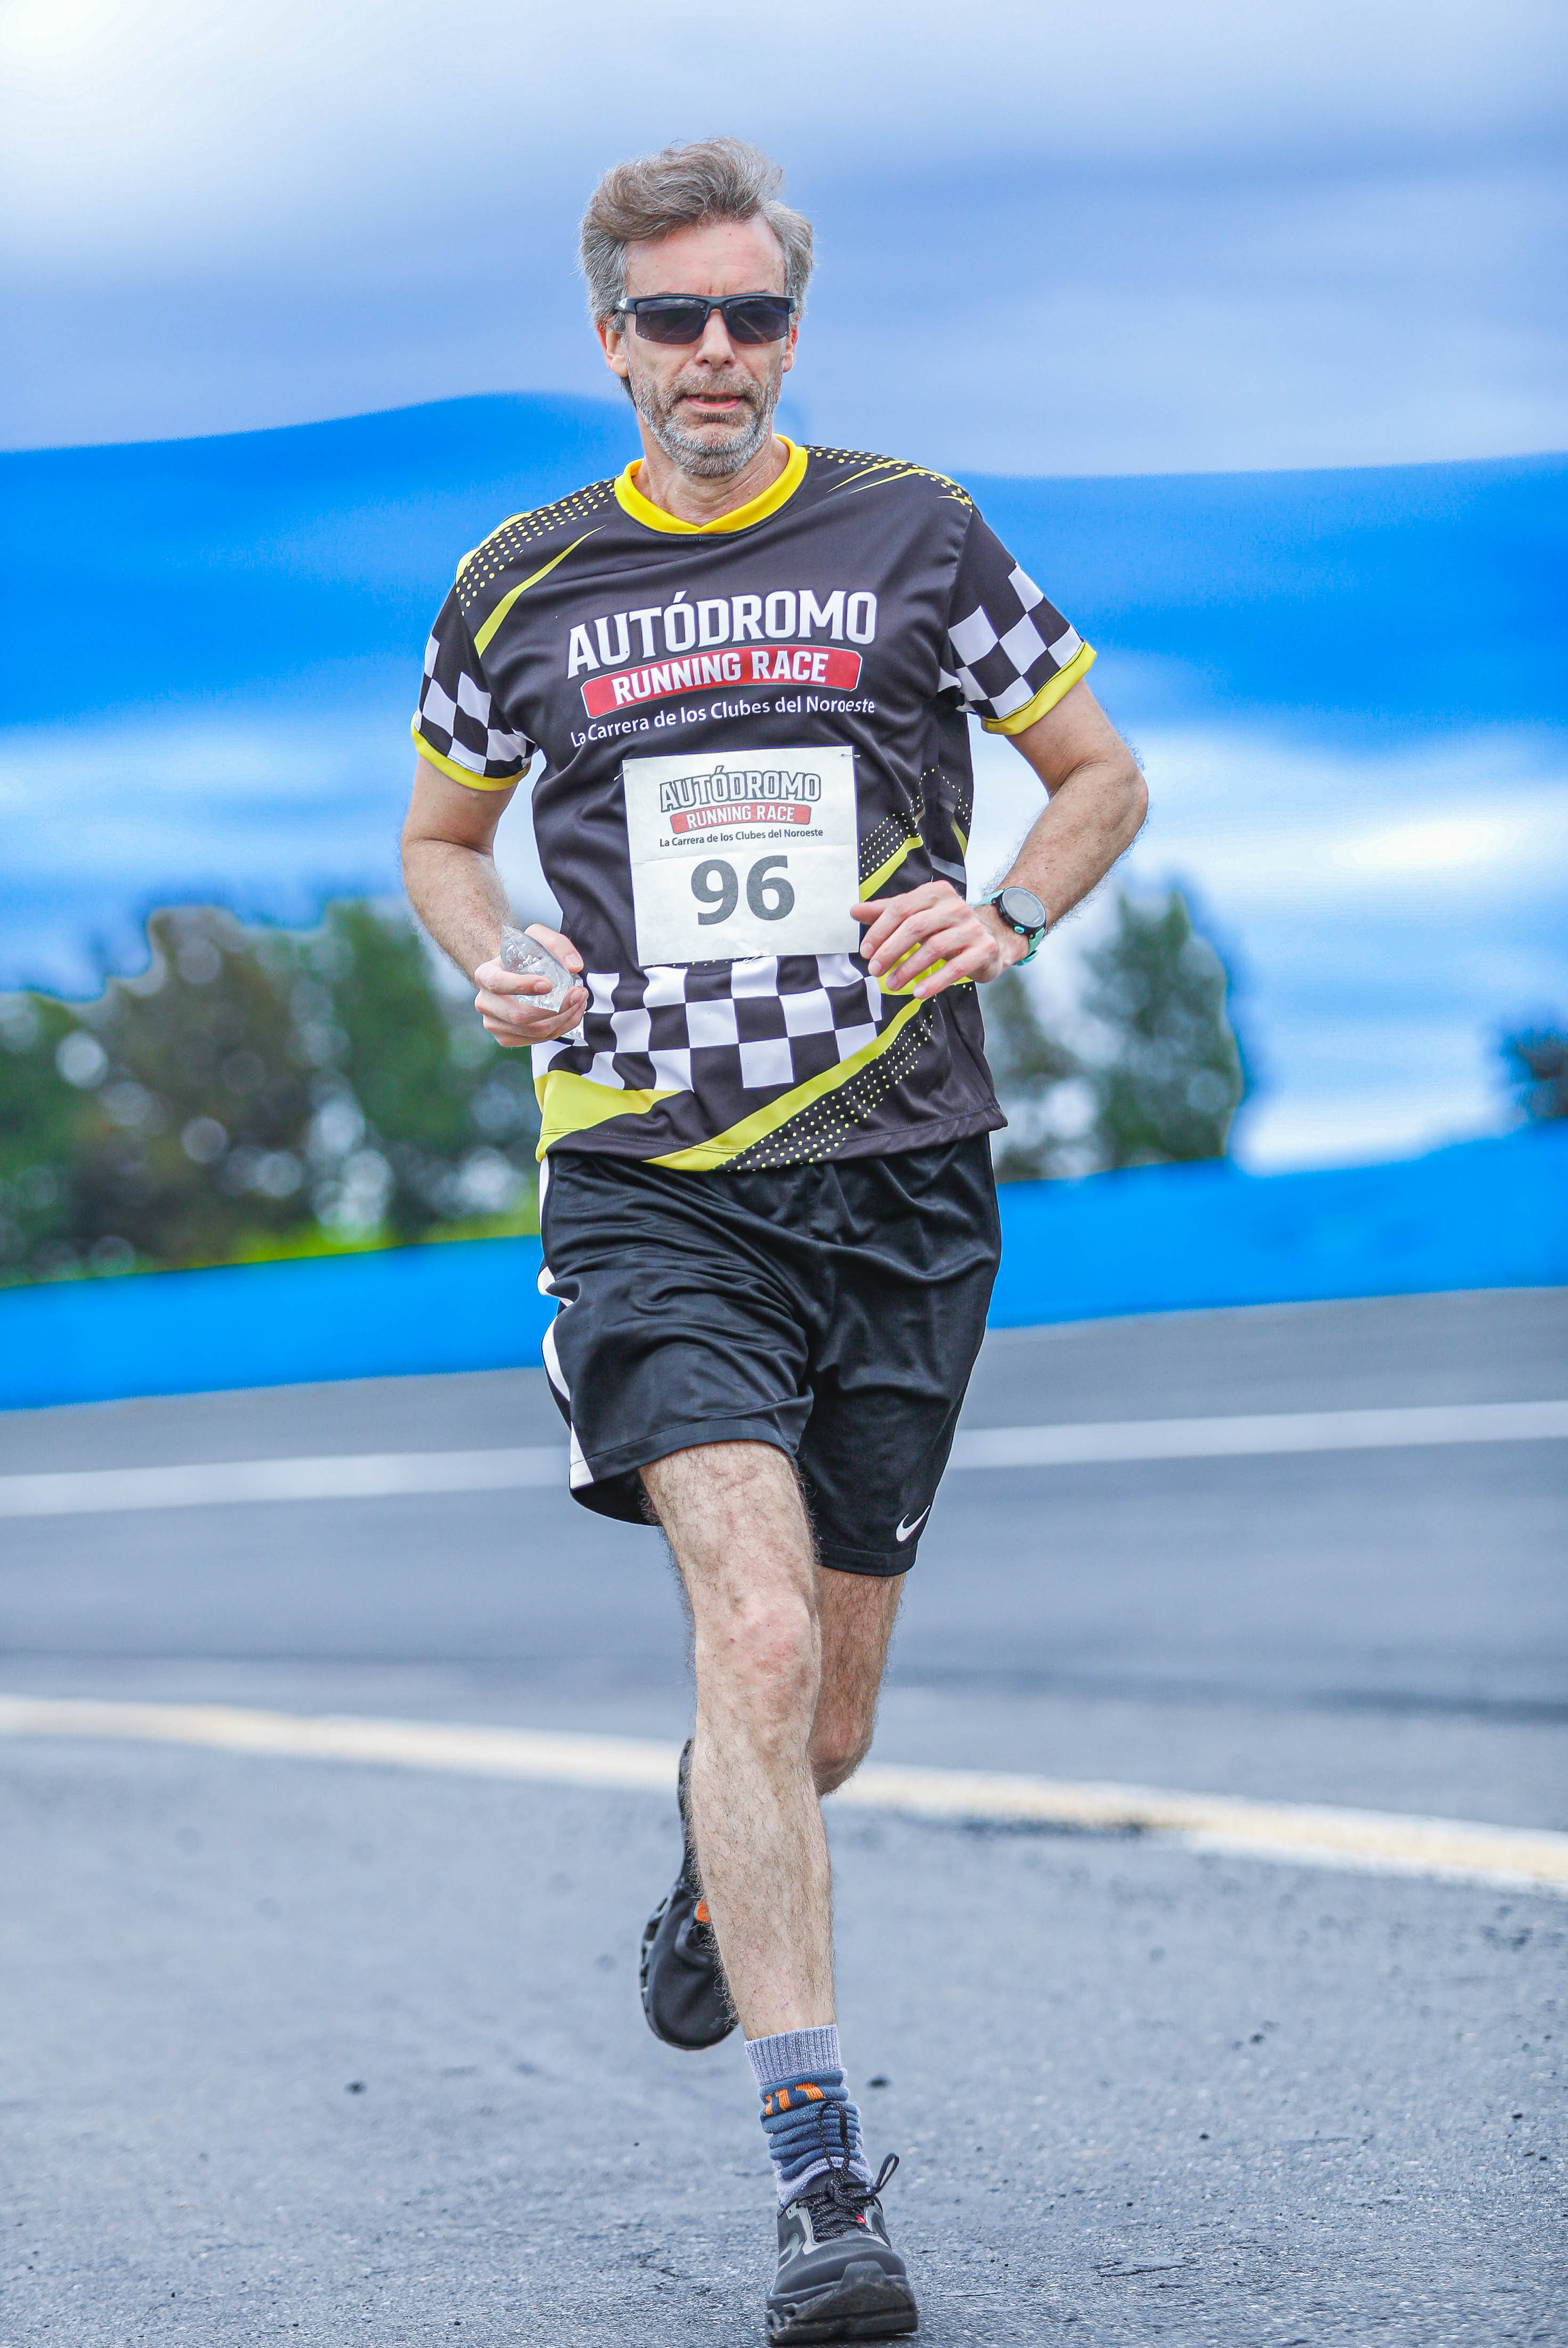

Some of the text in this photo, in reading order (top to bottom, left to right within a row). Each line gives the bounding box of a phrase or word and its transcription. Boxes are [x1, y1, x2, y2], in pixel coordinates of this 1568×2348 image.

[567, 589, 878, 679] AUTÓDROMO
[612, 650, 830, 706] RUNNING RACE
[570, 695, 875, 748] La Carrera de los Clubes del Noroeste
[659, 765, 821, 813] AUTÓDROMO
[660, 828, 823, 847] La Carrera de los Clubes del Noroeste
[686, 805, 794, 830] RUNNING RACE
[691, 855, 795, 925] 96
